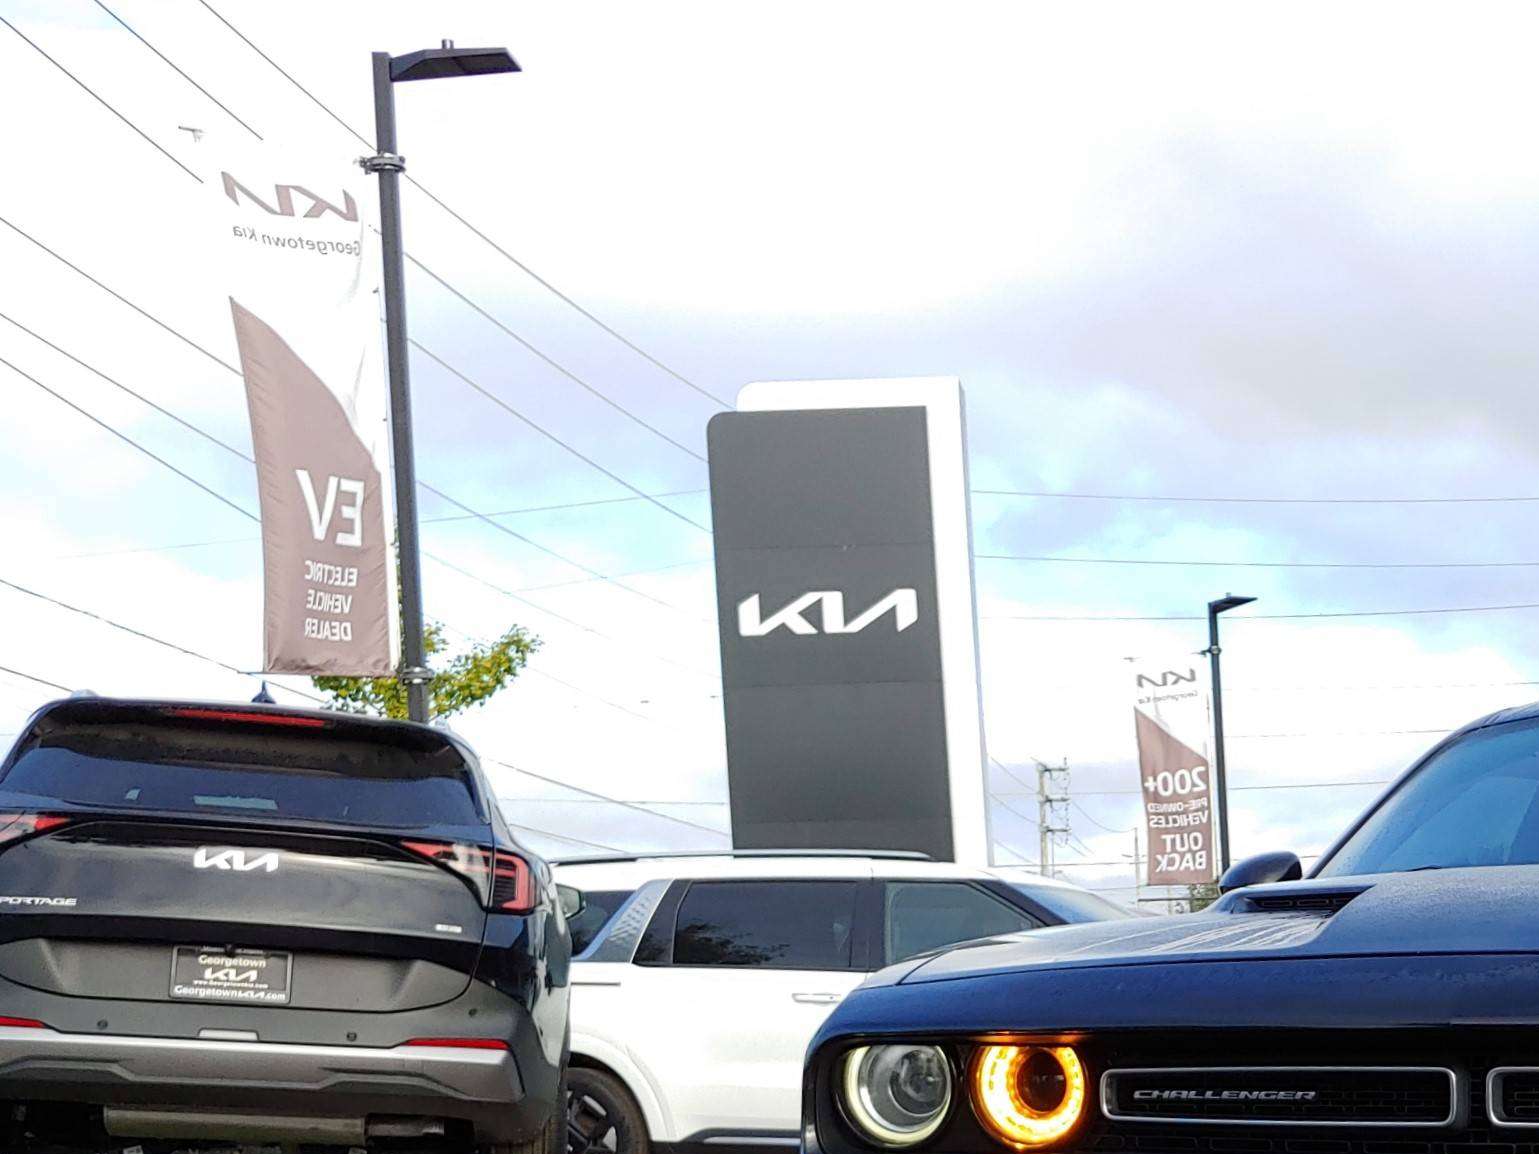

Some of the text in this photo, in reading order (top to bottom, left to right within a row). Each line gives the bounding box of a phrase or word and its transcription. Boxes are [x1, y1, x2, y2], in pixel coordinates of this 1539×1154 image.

[738, 588, 918, 637] KIA
[193, 848, 279, 872] KIA
[0, 896, 78, 907] PORTAGE
[198, 954, 267, 968] Georgetown
[204, 967, 258, 982] KIA
[1133, 1089, 1316, 1100] CHALLENGER
